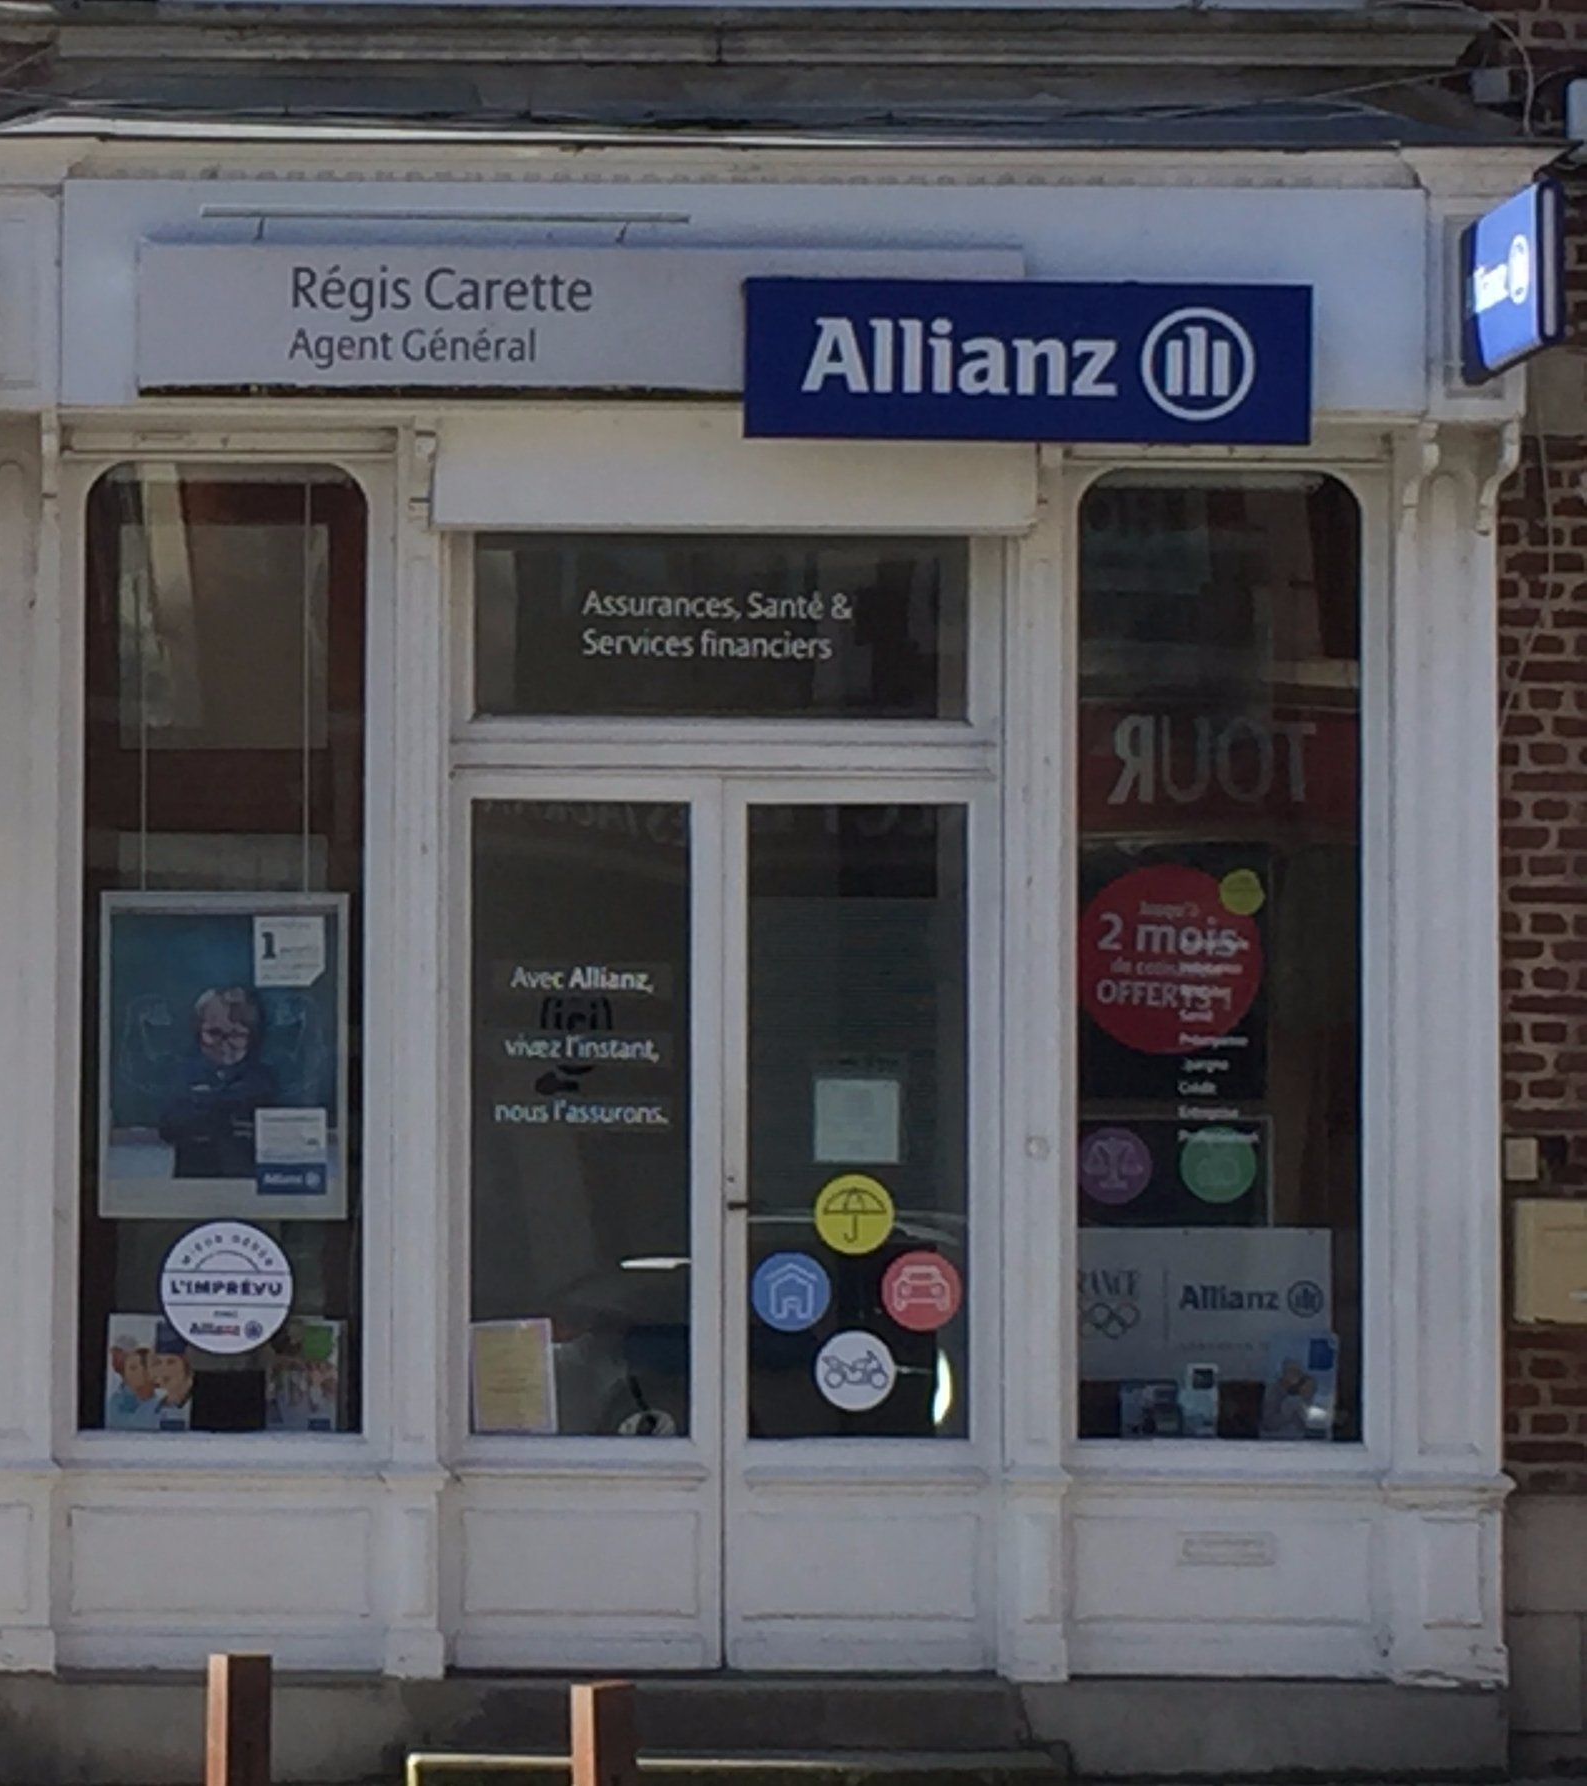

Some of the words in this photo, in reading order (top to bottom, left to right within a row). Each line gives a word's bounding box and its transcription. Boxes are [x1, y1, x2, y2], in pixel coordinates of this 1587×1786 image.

[292, 264, 412, 323] Régis
[425, 266, 593, 312] Carette
[288, 327, 394, 371] Agent
[401, 326, 537, 362] Général
[801, 316, 1119, 397] Allianz
[581, 590, 742, 621] Assurances,
[747, 591, 825, 619] Santé
[830, 592, 854, 620] &
[581, 628, 695, 657] Services
[700, 629, 833, 660] financiers
[260, 932, 277, 961] 1
[1097, 911, 1123, 950] 2
[1135, 916, 1238, 958] mois
[510, 966, 564, 989] Avec
[568, 966, 655, 993] Allianz,
[504, 1033, 562, 1059] vivez
[494, 1103, 549, 1123] nous
[170, 1277, 284, 1297] L'IMPRÉVU
[1179, 1284, 1280, 1311] Allianz
